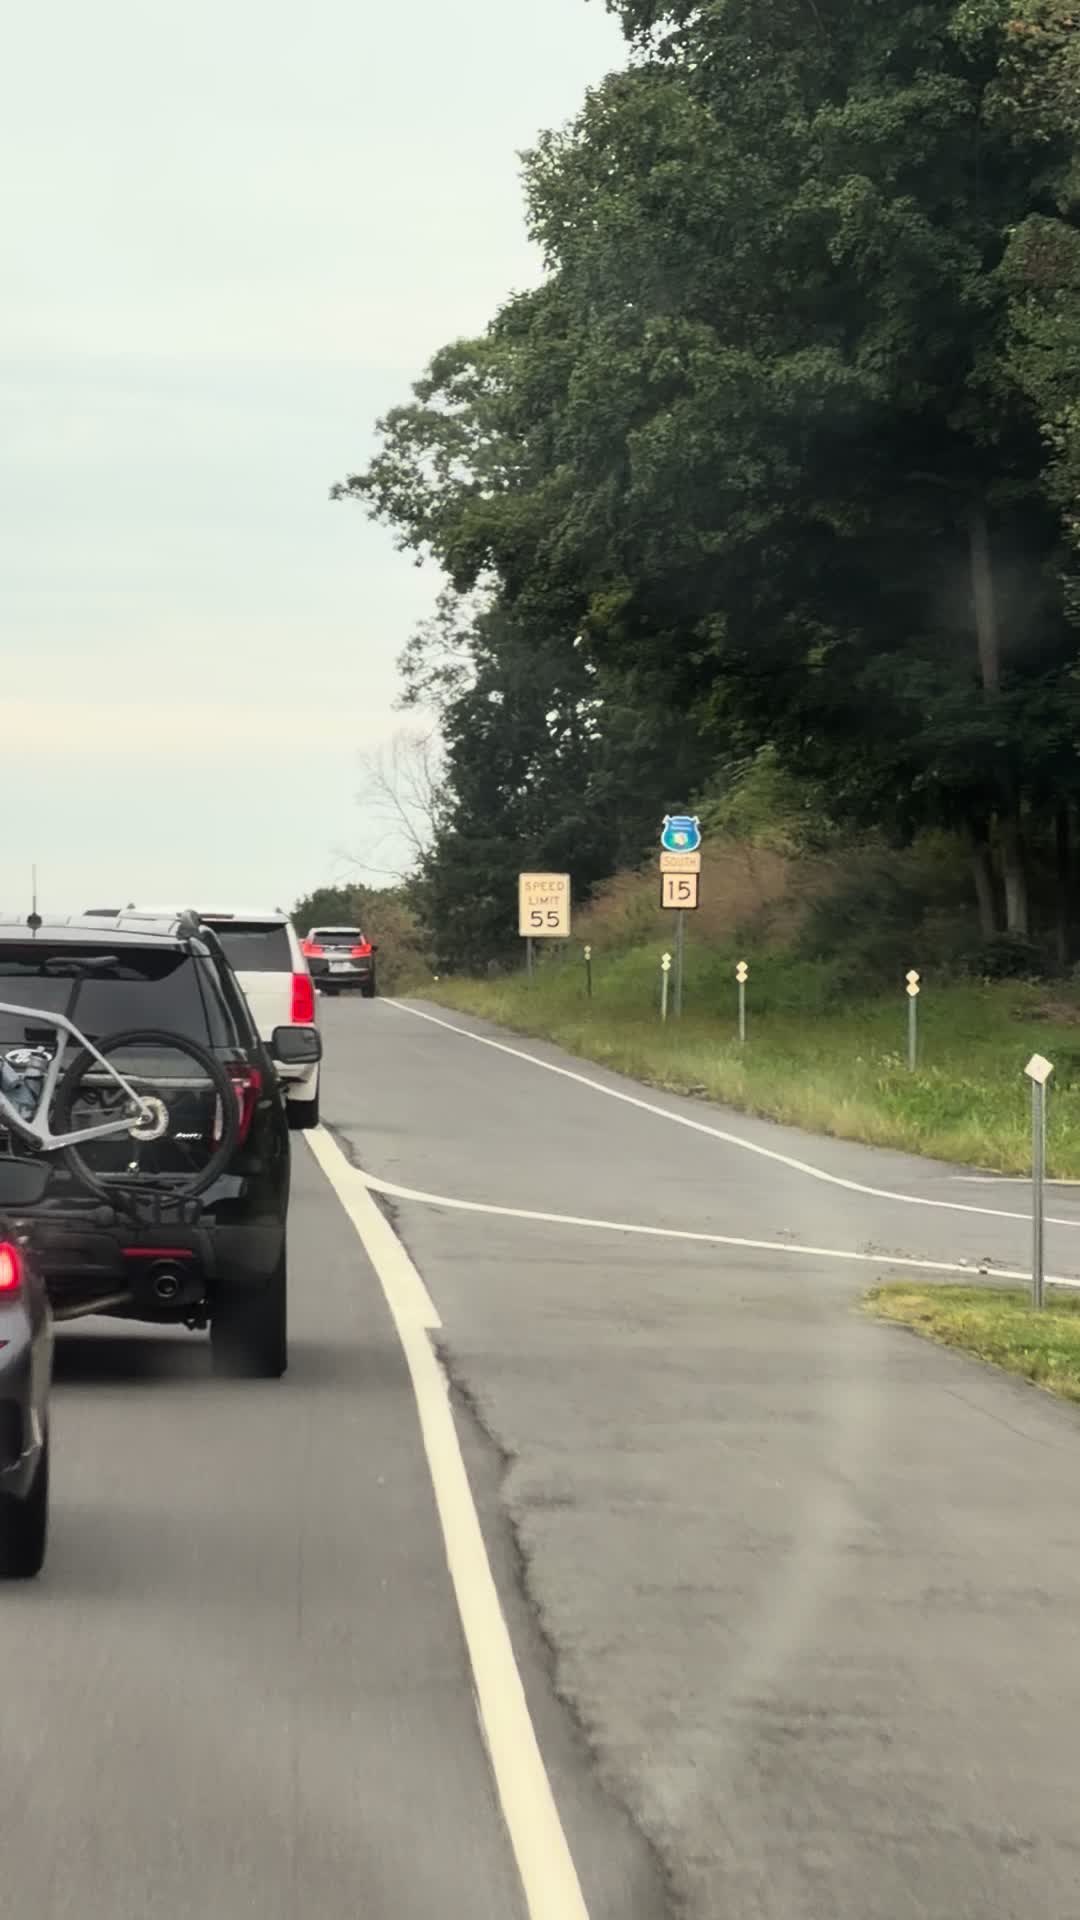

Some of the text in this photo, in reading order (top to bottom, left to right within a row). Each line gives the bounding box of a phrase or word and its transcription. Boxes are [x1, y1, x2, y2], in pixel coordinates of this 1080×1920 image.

[525, 881, 565, 892] SPEED
[668, 880, 691, 901] 15
[528, 896, 561, 906] LIMIT
[530, 910, 560, 928] 55
